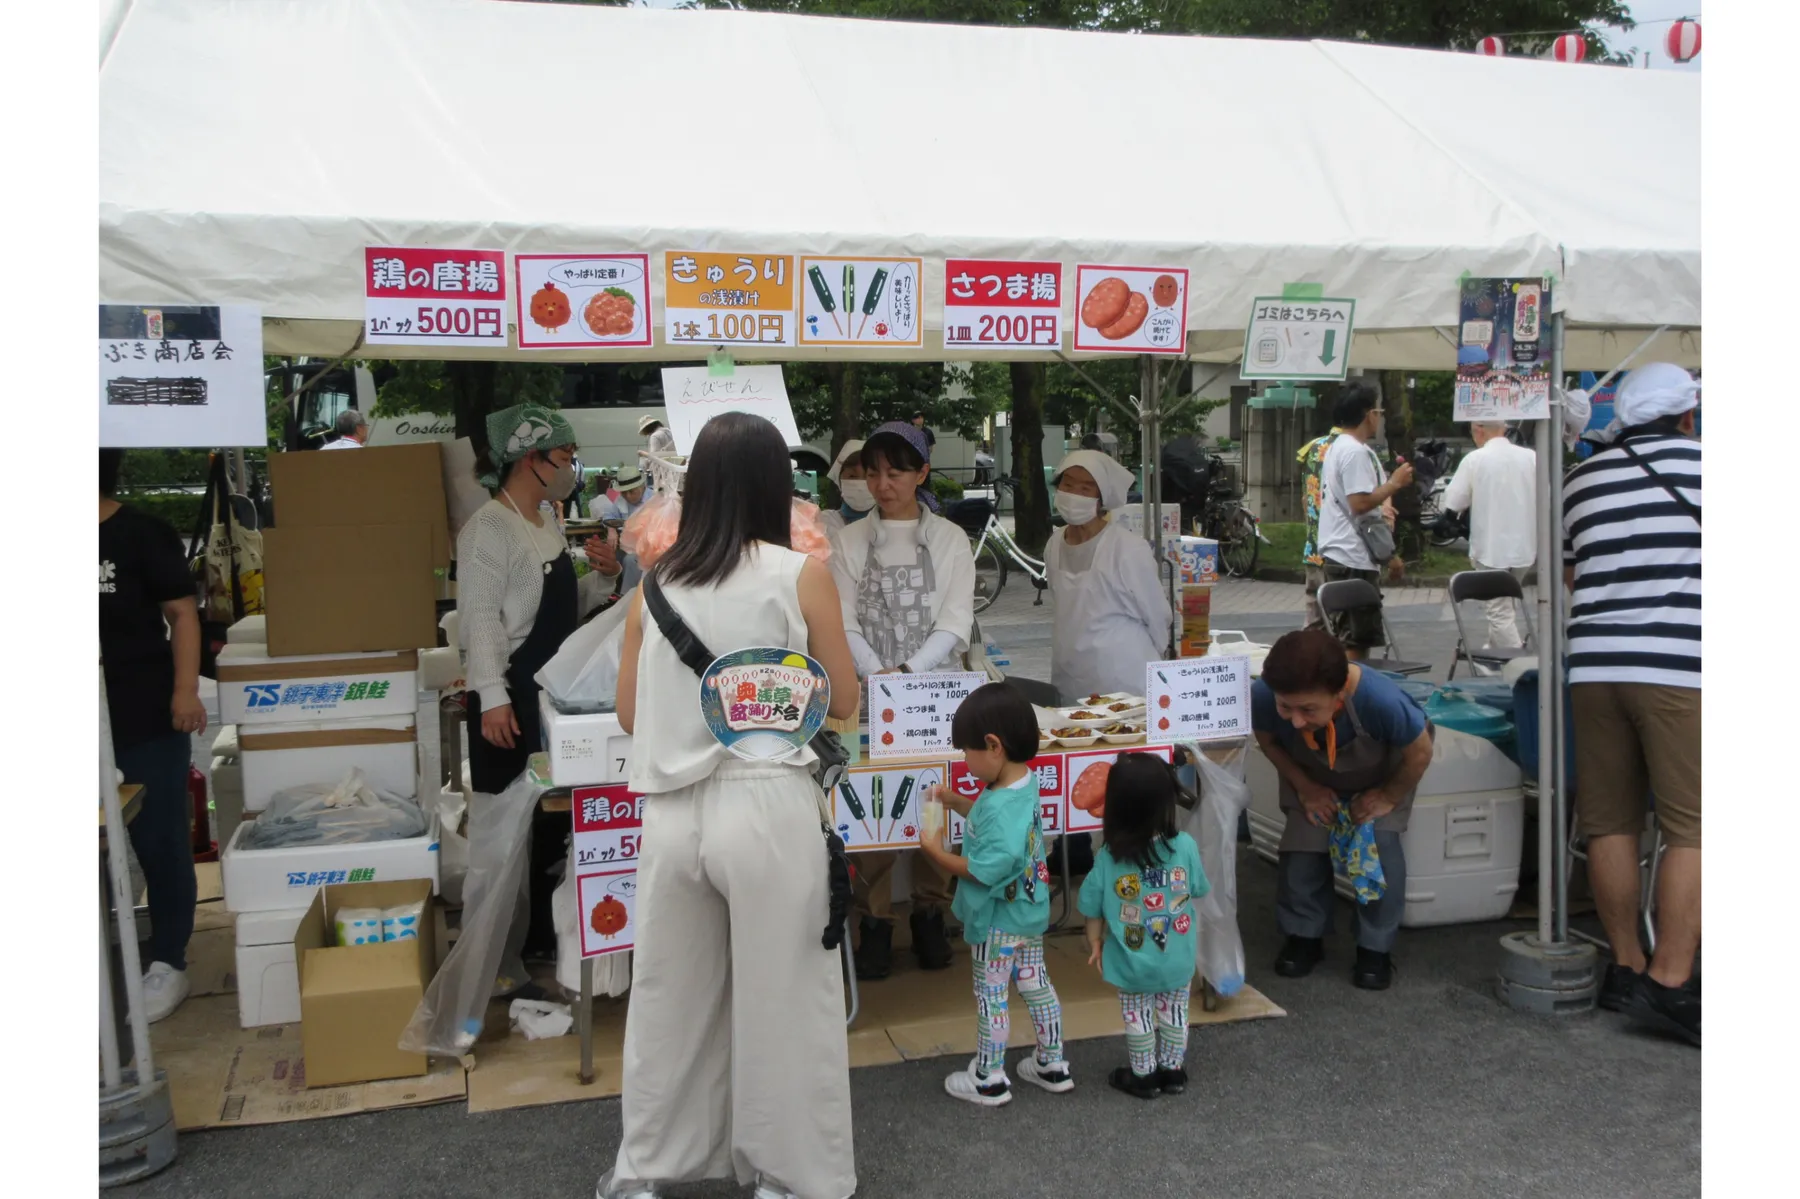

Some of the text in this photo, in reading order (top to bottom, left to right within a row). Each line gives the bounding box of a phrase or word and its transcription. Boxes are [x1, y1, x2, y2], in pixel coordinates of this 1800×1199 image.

[372, 257, 499, 293] 鶏の唐揚
[672, 256, 785, 286] きゅうり
[951, 271, 1057, 301] さつま揚
[698, 289, 760, 306] の浅漬け
[416, 306, 502, 336] 500円
[1256, 306, 1345, 321] ゴミはこちらへ
[673, 313, 784, 342] 1本 100円
[947, 314, 1057, 344] 1皿 200円
[682, 377, 763, 398] えびせん
[1216, 673, 1236, 683] 100円
[343, 679, 391, 701] 銀鮭
[736, 681, 793, 704] 奥浅草
[946, 689, 969, 699] 100円
[1216, 696, 1236, 706] 200円
[729, 703, 800, 722] 盆踊り大会
[1218, 718, 1238, 728] 500円
[615, 757, 626, 773] 7
